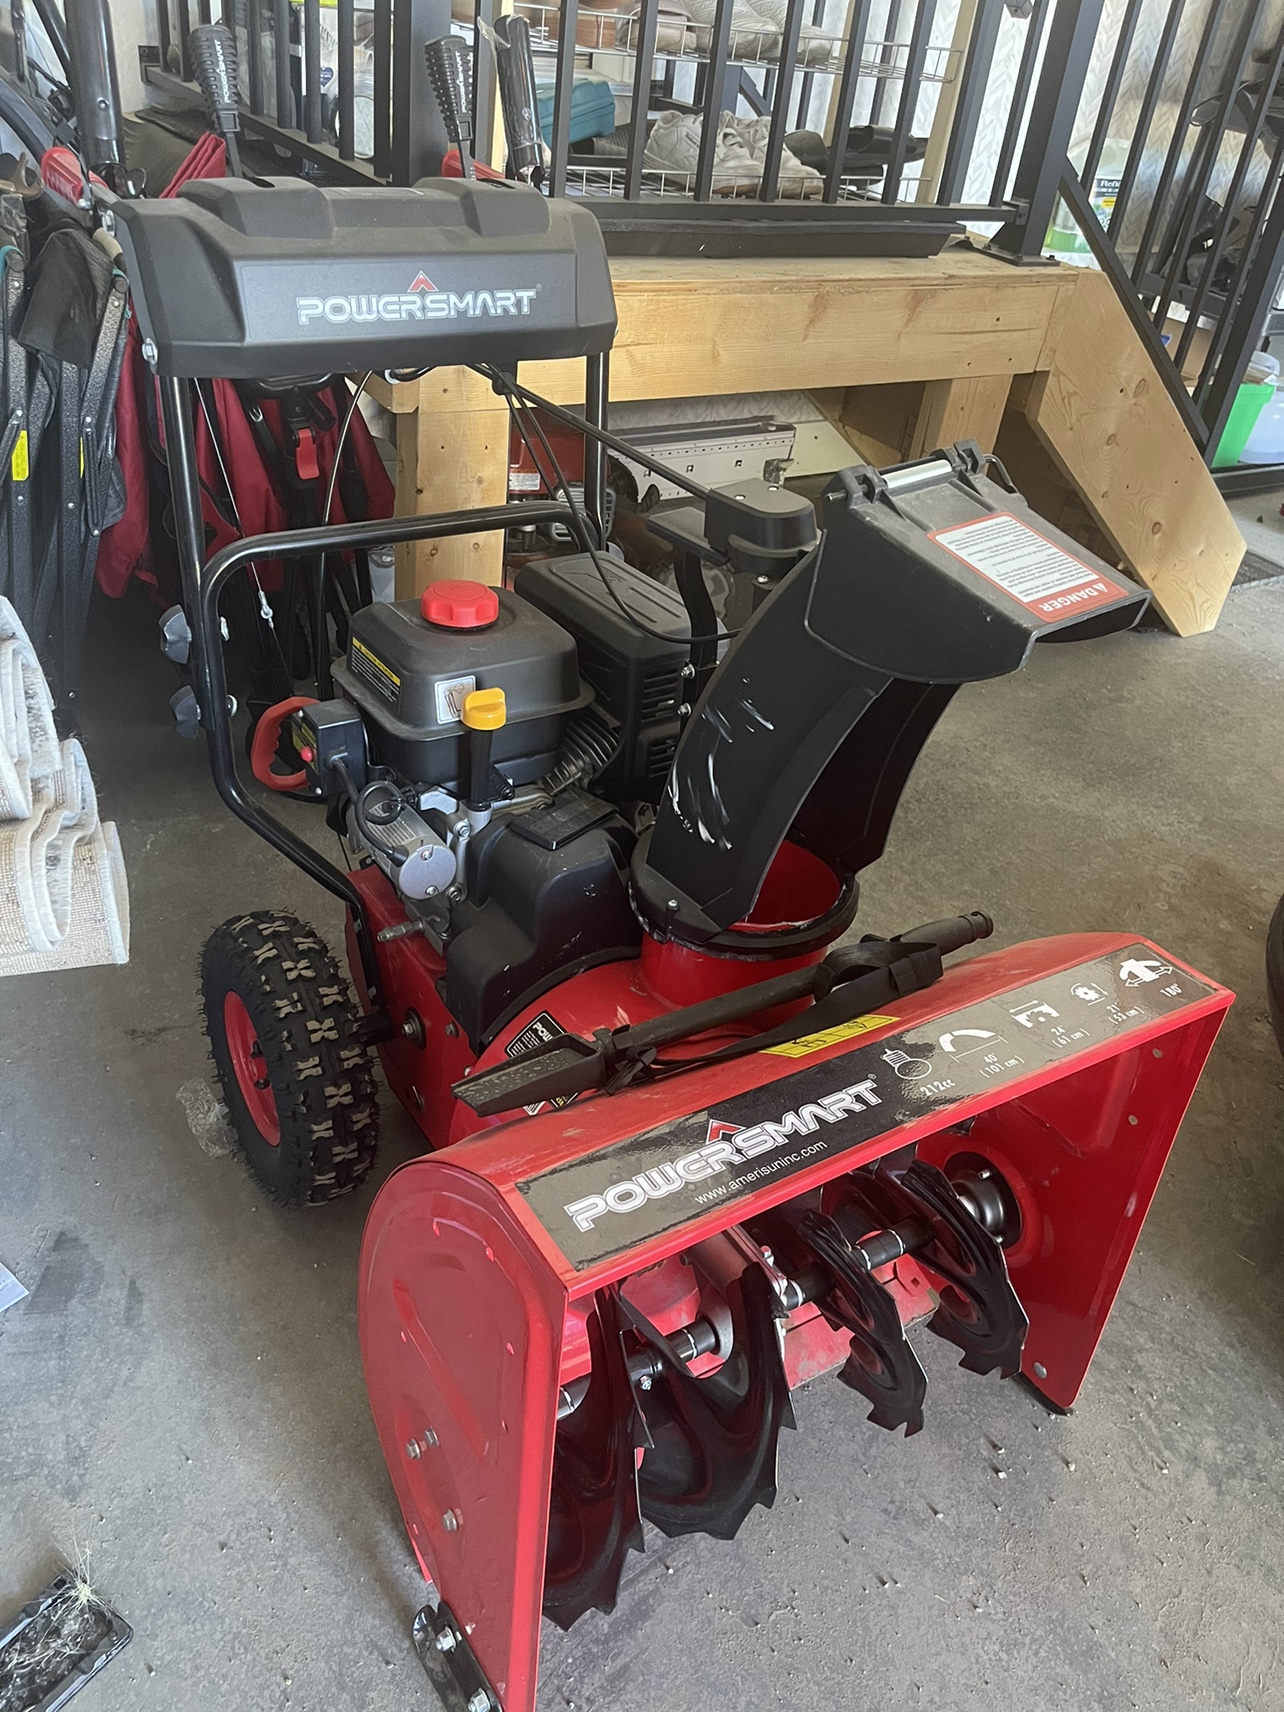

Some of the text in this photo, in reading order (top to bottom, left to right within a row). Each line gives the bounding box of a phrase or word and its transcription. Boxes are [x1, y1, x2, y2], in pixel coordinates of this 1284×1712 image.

[296, 287, 537, 326] POWERSMART
[1038, 585, 1099, 612] DANGER
[919, 1079, 956, 1096] 212cc
[562, 1078, 883, 1233] POWERSMART
[694, 1139, 828, 1205] www.amerisuninc.com
